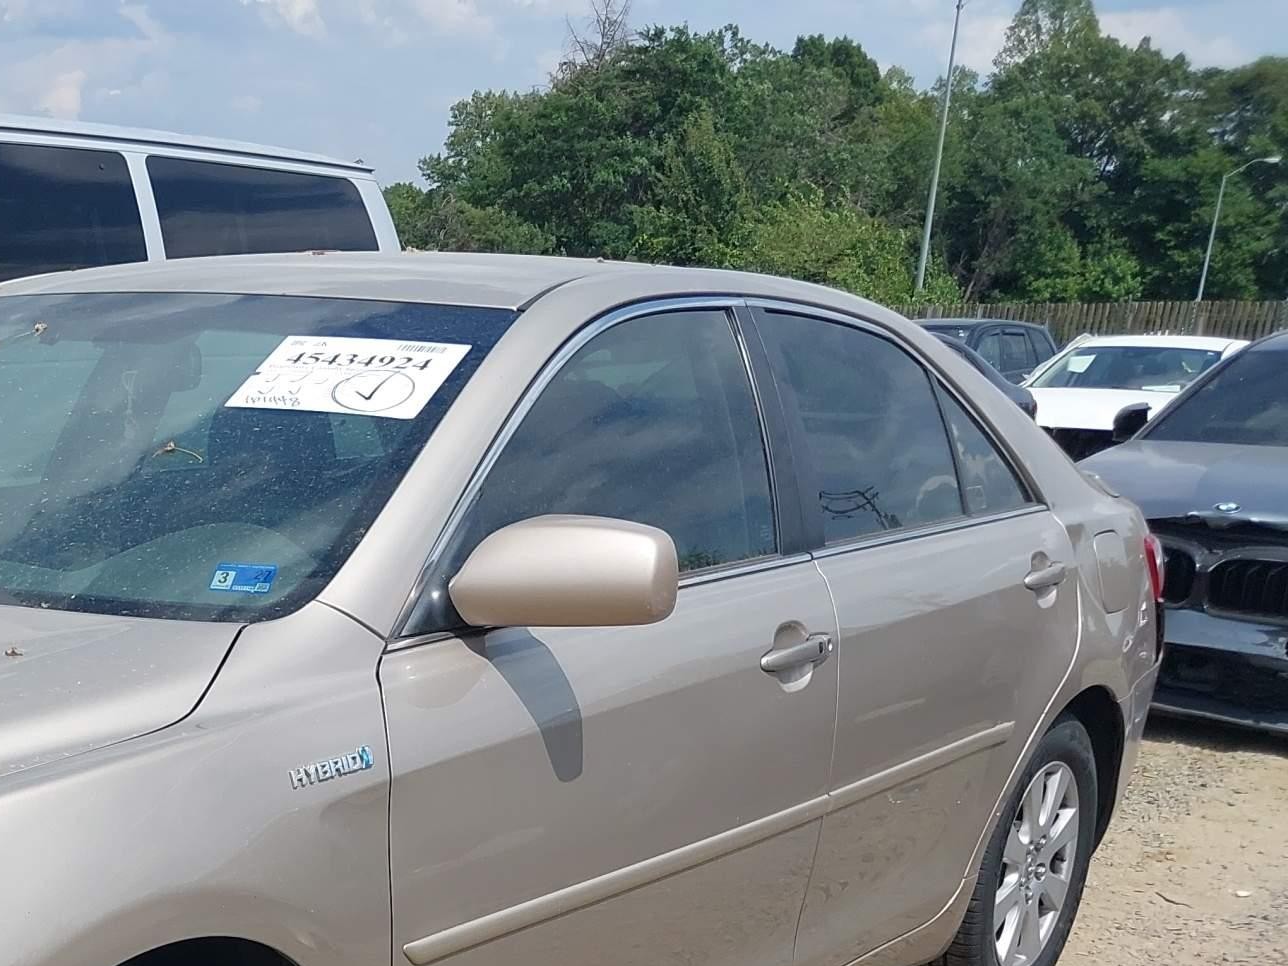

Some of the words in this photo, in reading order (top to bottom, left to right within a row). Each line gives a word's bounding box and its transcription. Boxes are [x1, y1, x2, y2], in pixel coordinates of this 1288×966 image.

[286, 352, 433, 371] 45434924
[217, 571, 230, 584] 3
[289, 752, 363, 789] HYBRID
